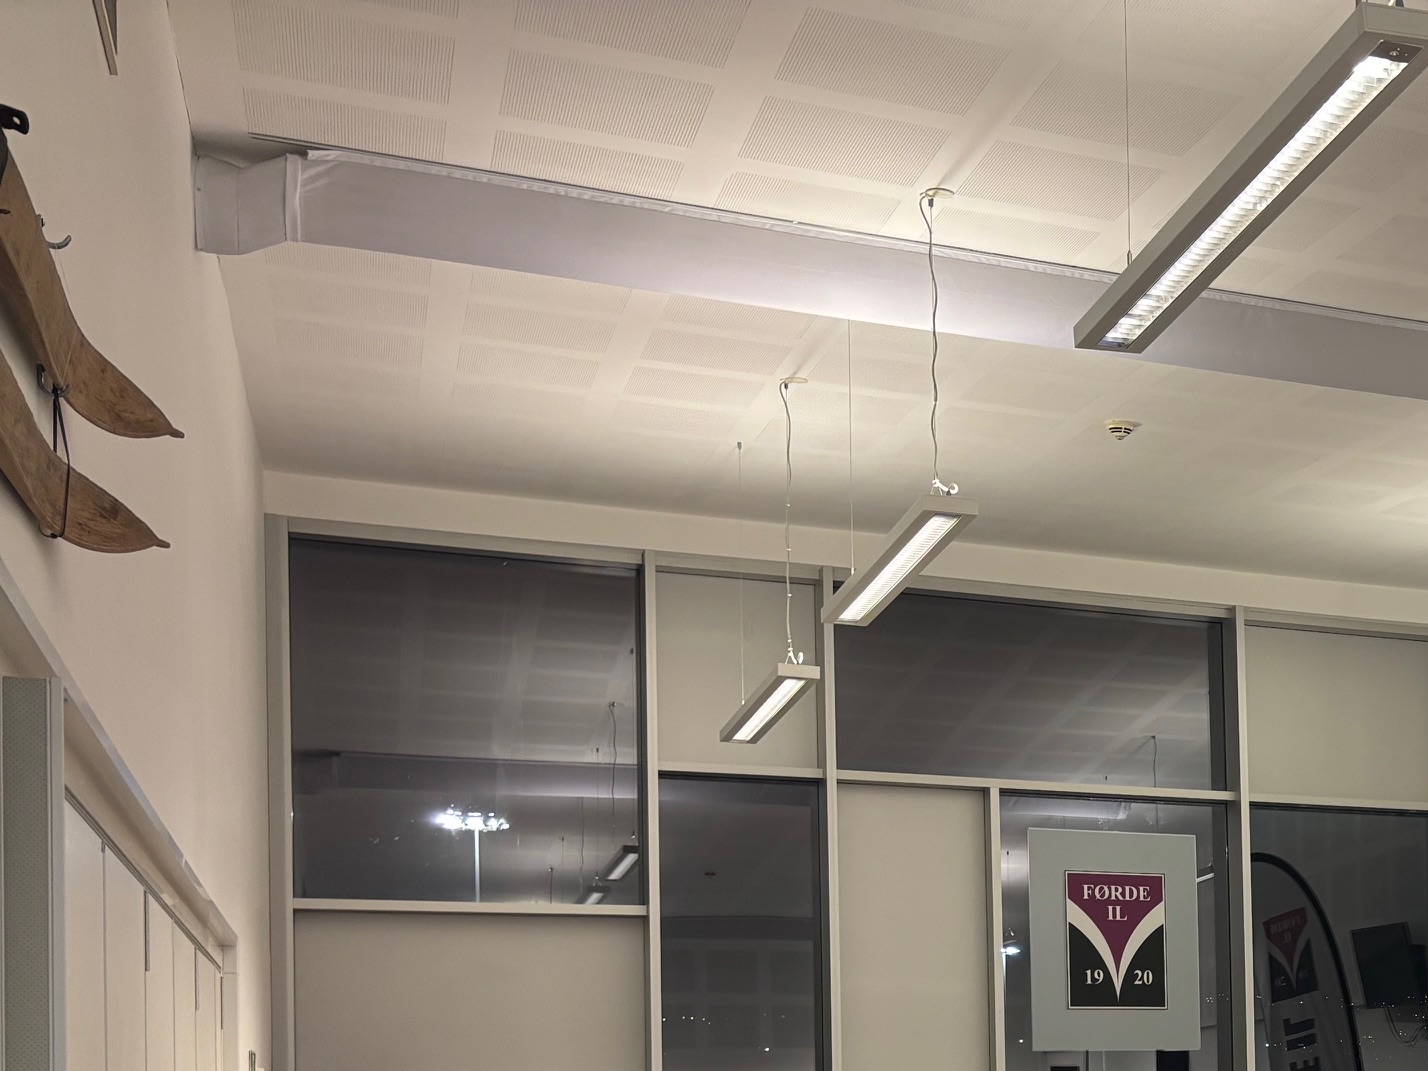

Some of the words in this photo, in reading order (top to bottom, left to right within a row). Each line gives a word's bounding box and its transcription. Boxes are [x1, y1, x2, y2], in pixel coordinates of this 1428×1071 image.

[1082, 884, 1151, 901] FØRDE
[1107, 905, 1128, 921] IL
[1085, 969, 1104, 985] 19
[1133, 969, 1153, 985] 20
